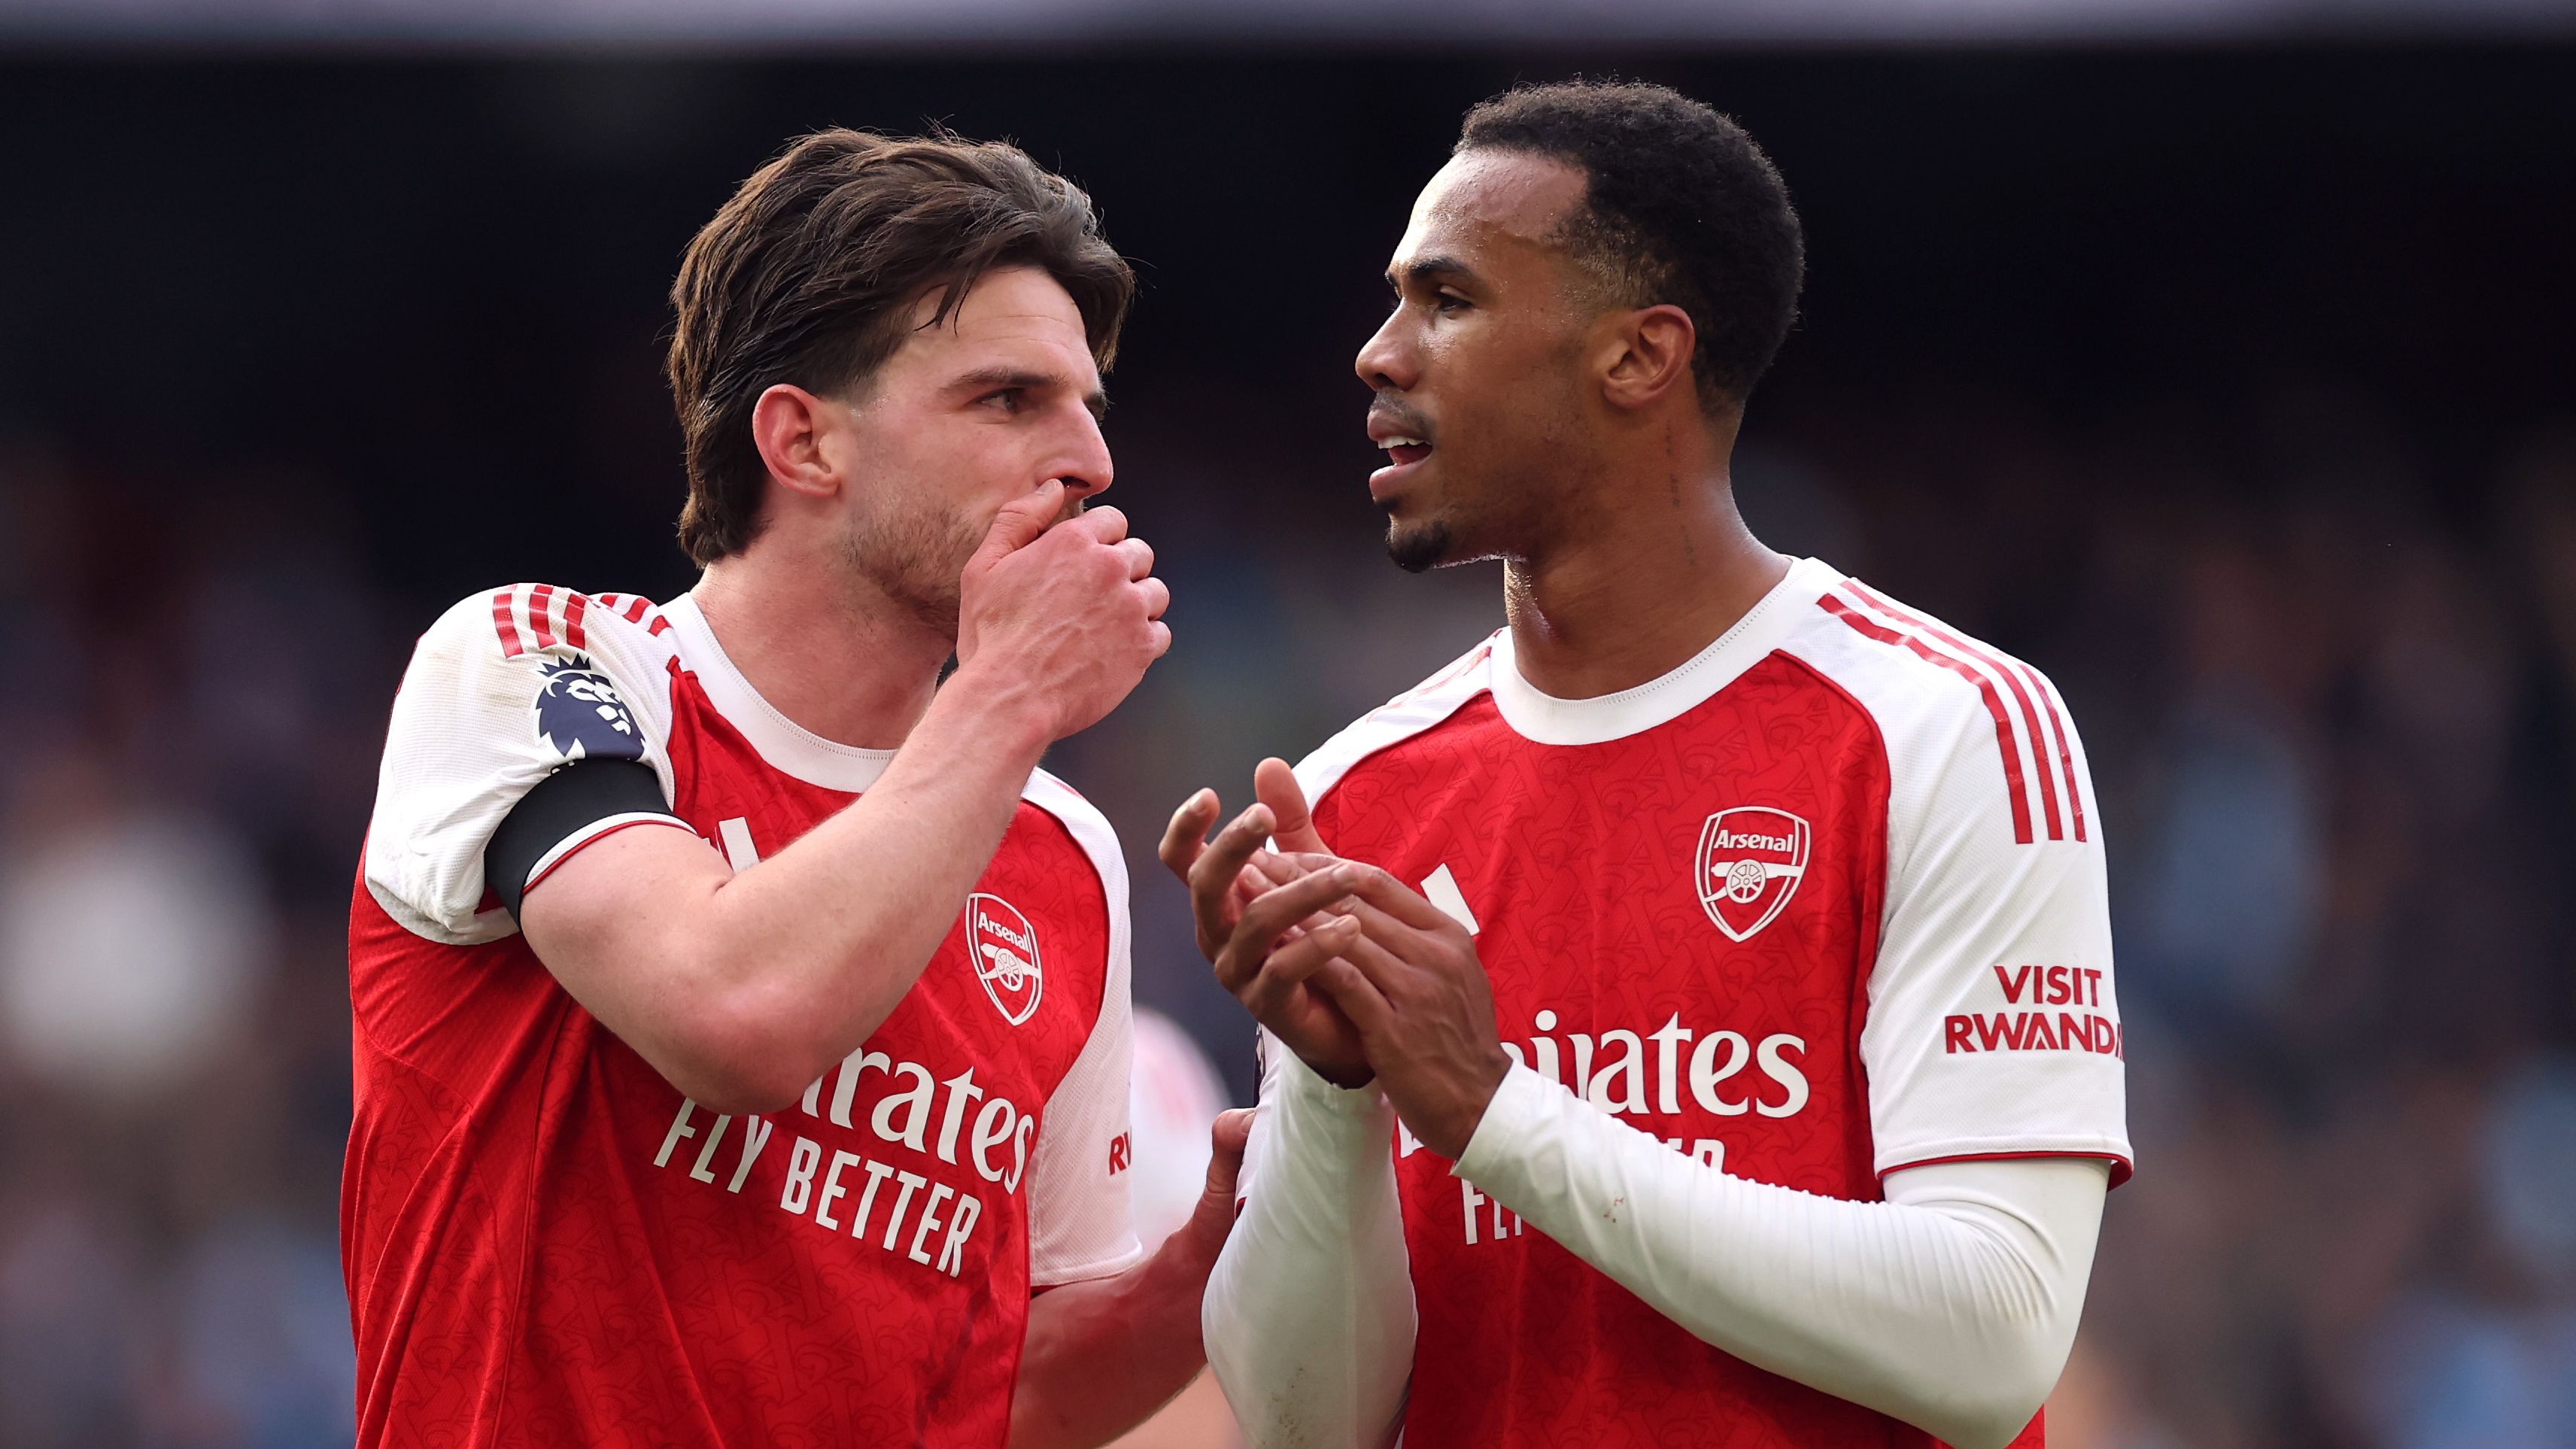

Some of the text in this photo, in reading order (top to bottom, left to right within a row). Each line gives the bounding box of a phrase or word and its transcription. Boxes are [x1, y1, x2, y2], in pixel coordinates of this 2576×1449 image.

[1713, 829, 1794, 852] Arsenal
[977, 912, 1031, 953] Arsenal
[1994, 965, 2101, 1007] VISIT
[779, 1135, 982, 1278] BETTER
